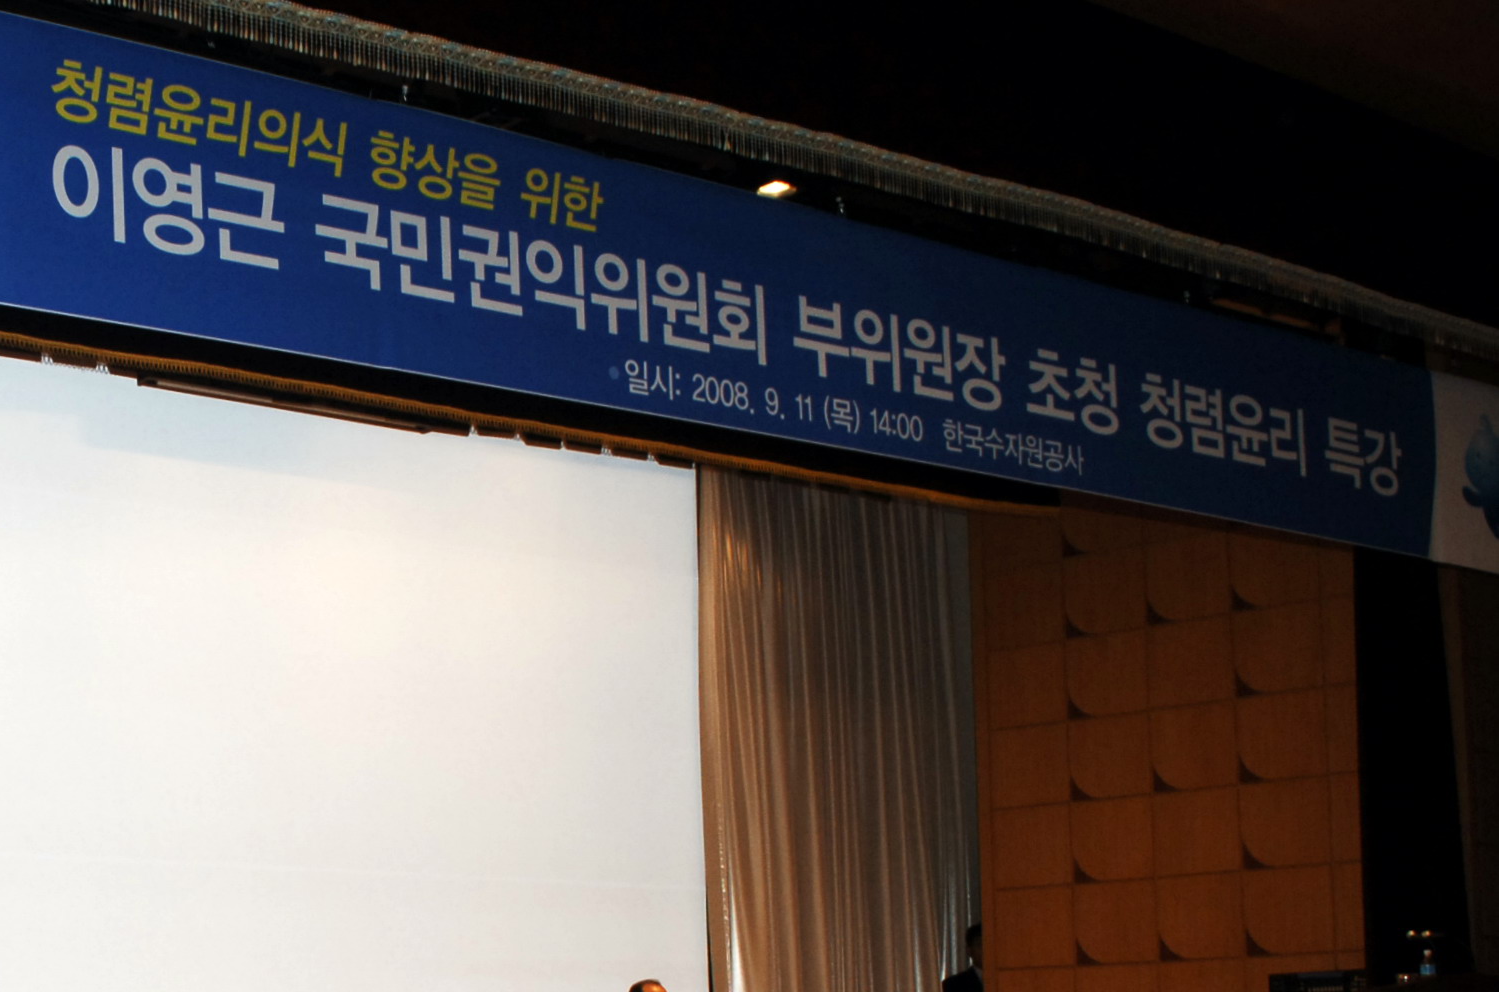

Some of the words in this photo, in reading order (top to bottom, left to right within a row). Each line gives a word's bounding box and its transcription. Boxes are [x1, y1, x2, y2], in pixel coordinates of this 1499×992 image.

[51, 59, 348, 177] 청렴윤리의식
[370, 131, 501, 210] 향상을
[521, 167, 604, 232] 위한
[52, 144, 285, 270] 이영근
[314, 194, 767, 366] 국민권익위원회
[793, 295, 1006, 411] 부위원장
[1027, 348, 1121, 436] 초청
[1140, 372, 1308, 477] 청렴윤리
[1325, 418, 1403, 497] 특강
[624, 359, 681, 400] 일시:
[692, 373, 755, 415] 2008.
[764, 387, 786, 420] 9.
[870, 408, 924, 442] 14:00
[942, 418, 1085, 476] 한국수자원공사
